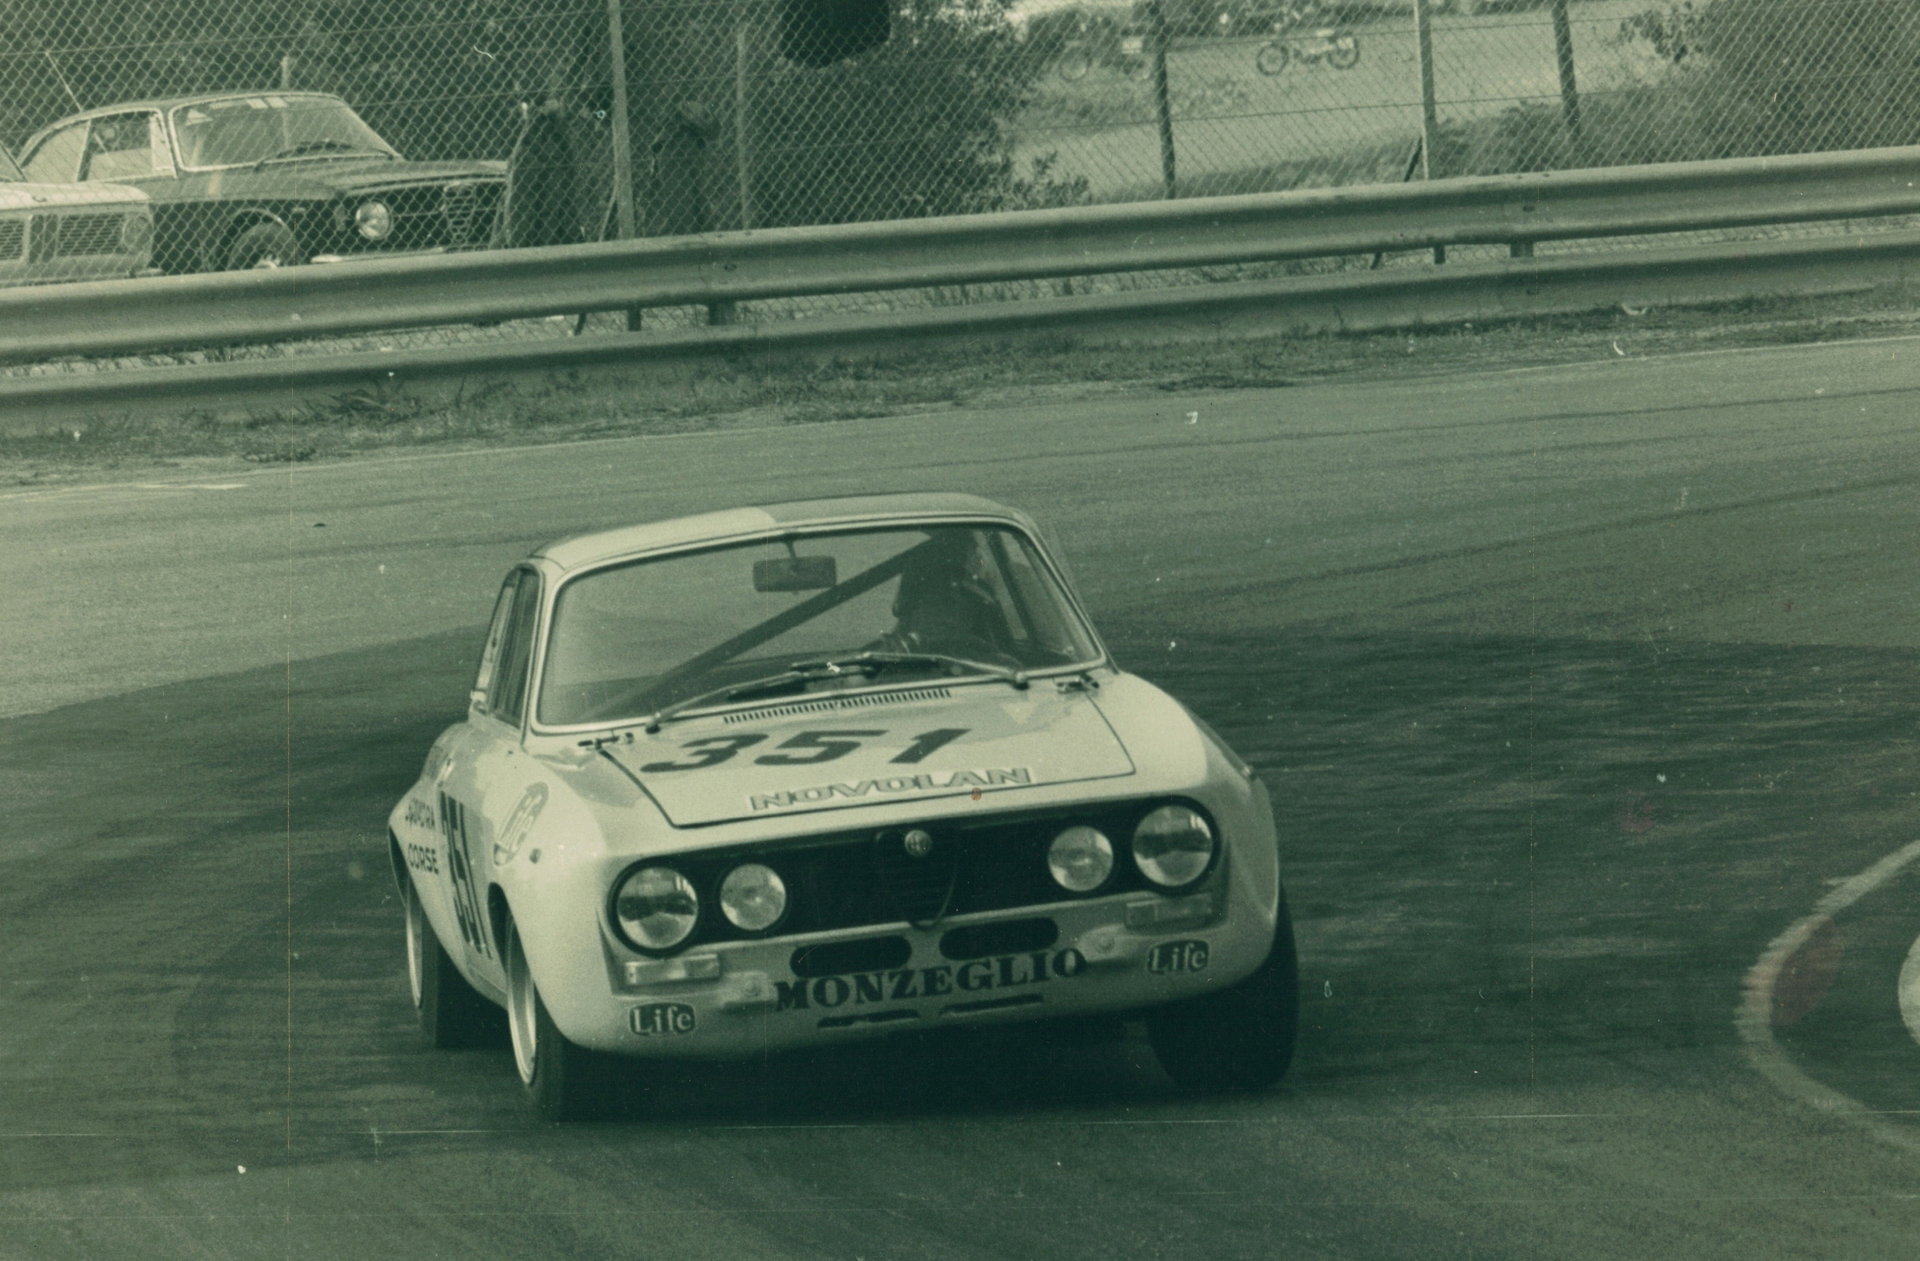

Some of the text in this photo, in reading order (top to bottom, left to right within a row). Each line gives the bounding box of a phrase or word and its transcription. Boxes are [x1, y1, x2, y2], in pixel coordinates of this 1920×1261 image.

[641, 728, 972, 773] 351
[750, 767, 1032, 811] NOVOLAN
[408, 843, 439, 874] CORSE
[1150, 943, 1206, 971] Life
[774, 947, 1087, 1012] MONZEGLIO
[633, 1006, 692, 1033] Life
